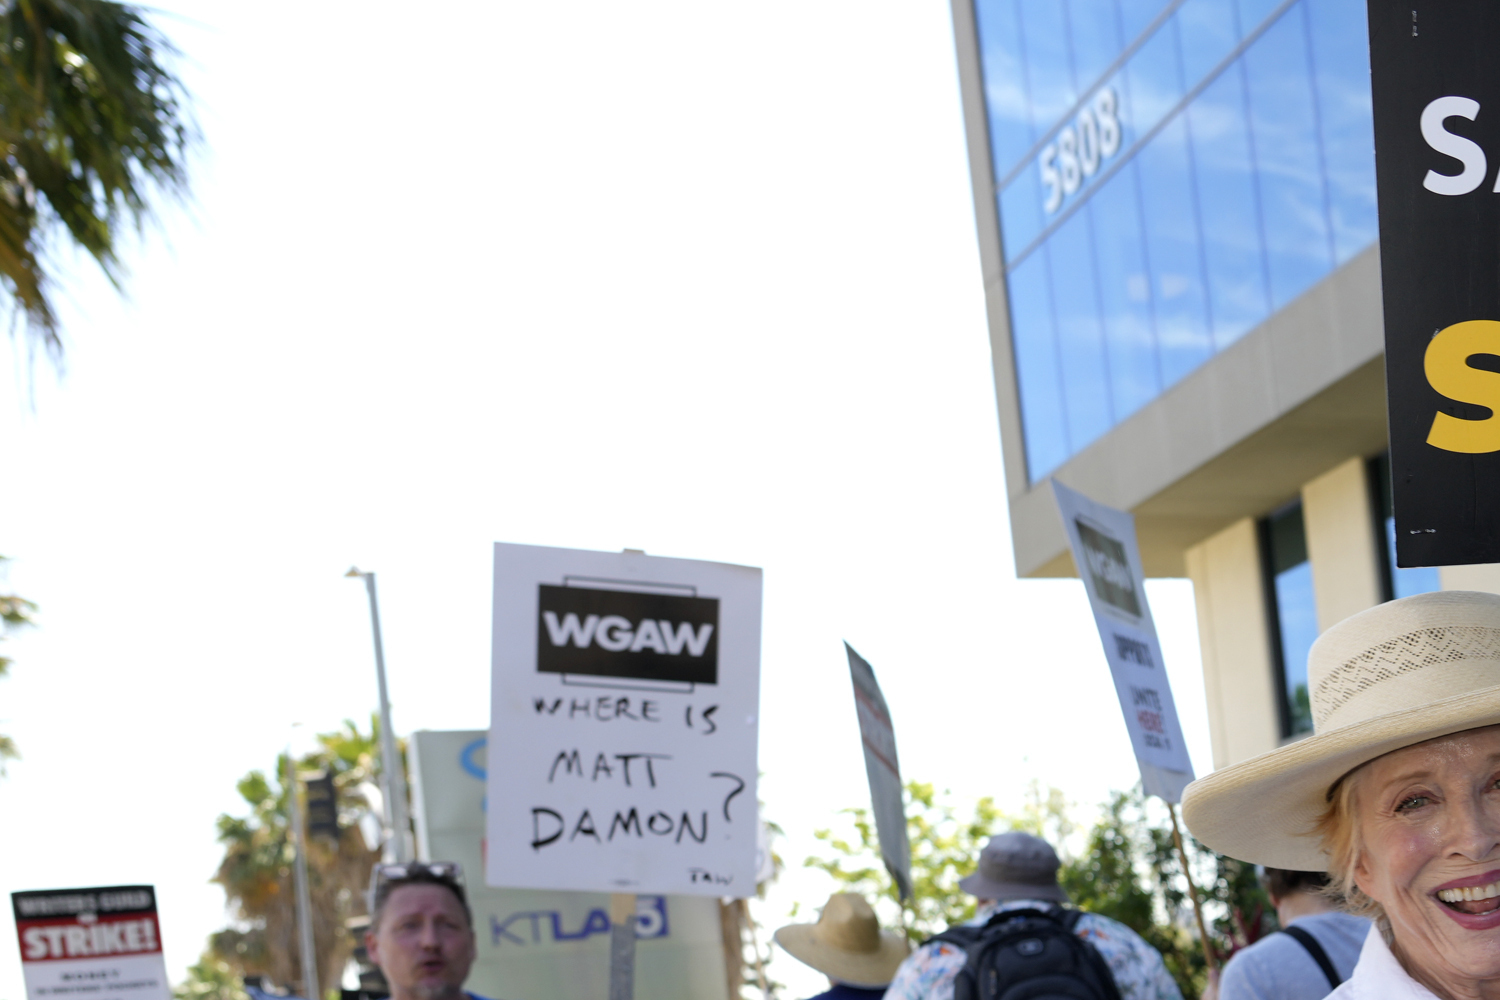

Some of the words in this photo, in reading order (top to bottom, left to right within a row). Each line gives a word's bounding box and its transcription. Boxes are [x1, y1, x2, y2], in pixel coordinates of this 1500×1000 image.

[1039, 86, 1120, 214] 5808
[543, 610, 714, 657] WGAW
[532, 696, 661, 722] WHERE
[685, 703, 719, 735] IS
[549, 749, 674, 788] MATT
[530, 771, 745, 852] DAMON?
[23, 918, 158, 960] STRIKE!
[490, 907, 612, 946] KTLA
